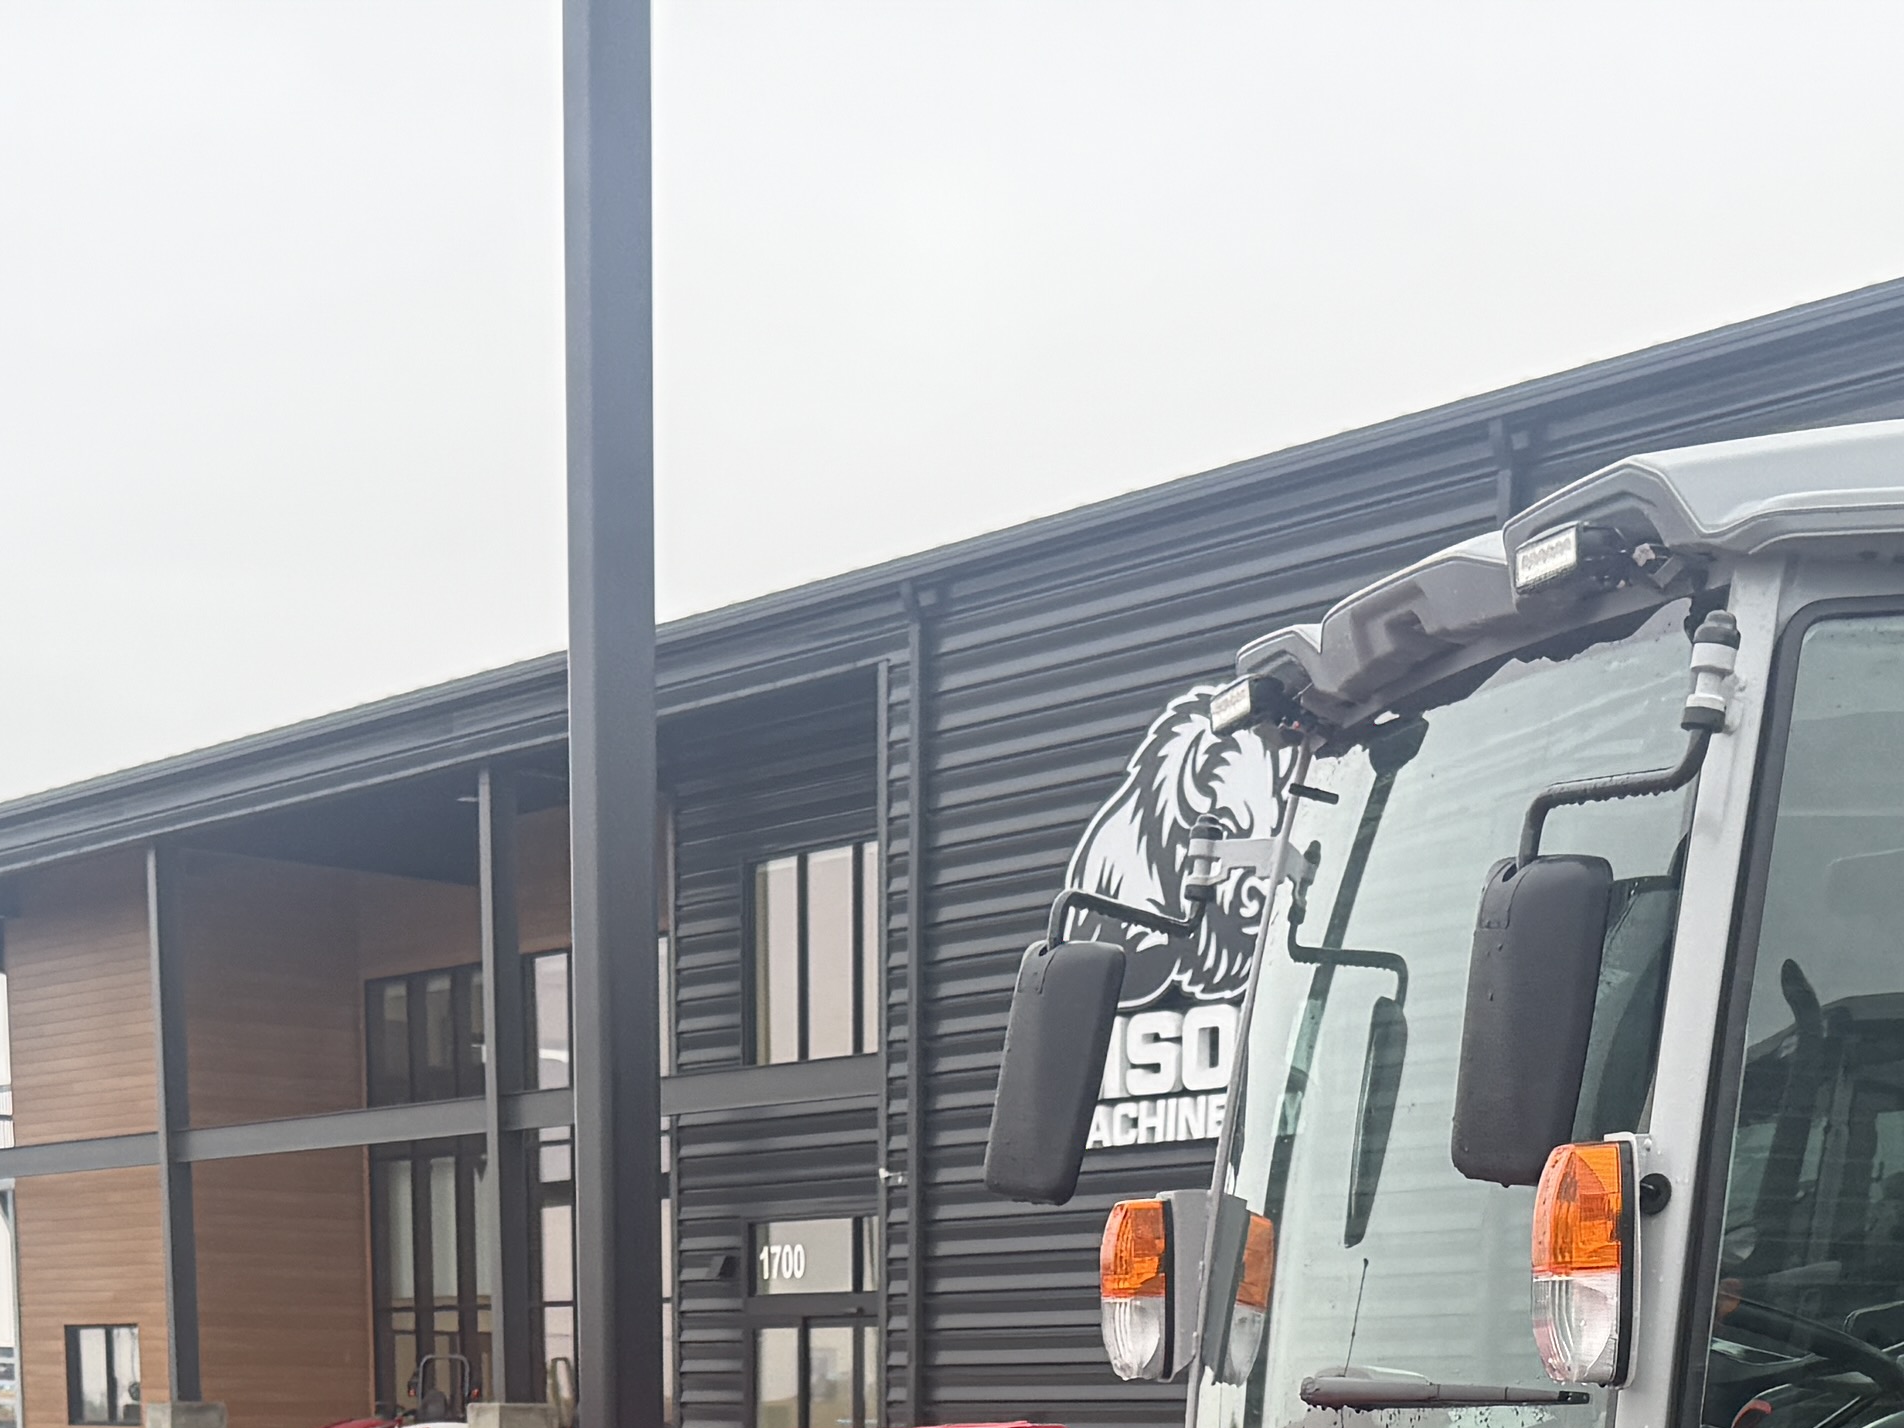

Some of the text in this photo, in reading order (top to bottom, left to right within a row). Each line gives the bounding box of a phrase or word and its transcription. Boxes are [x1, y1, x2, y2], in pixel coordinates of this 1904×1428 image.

[1098, 1004, 1238, 1100] ISO
[1085, 1093, 1228, 1150] ACHINE
[759, 1243, 806, 1280] 1700
